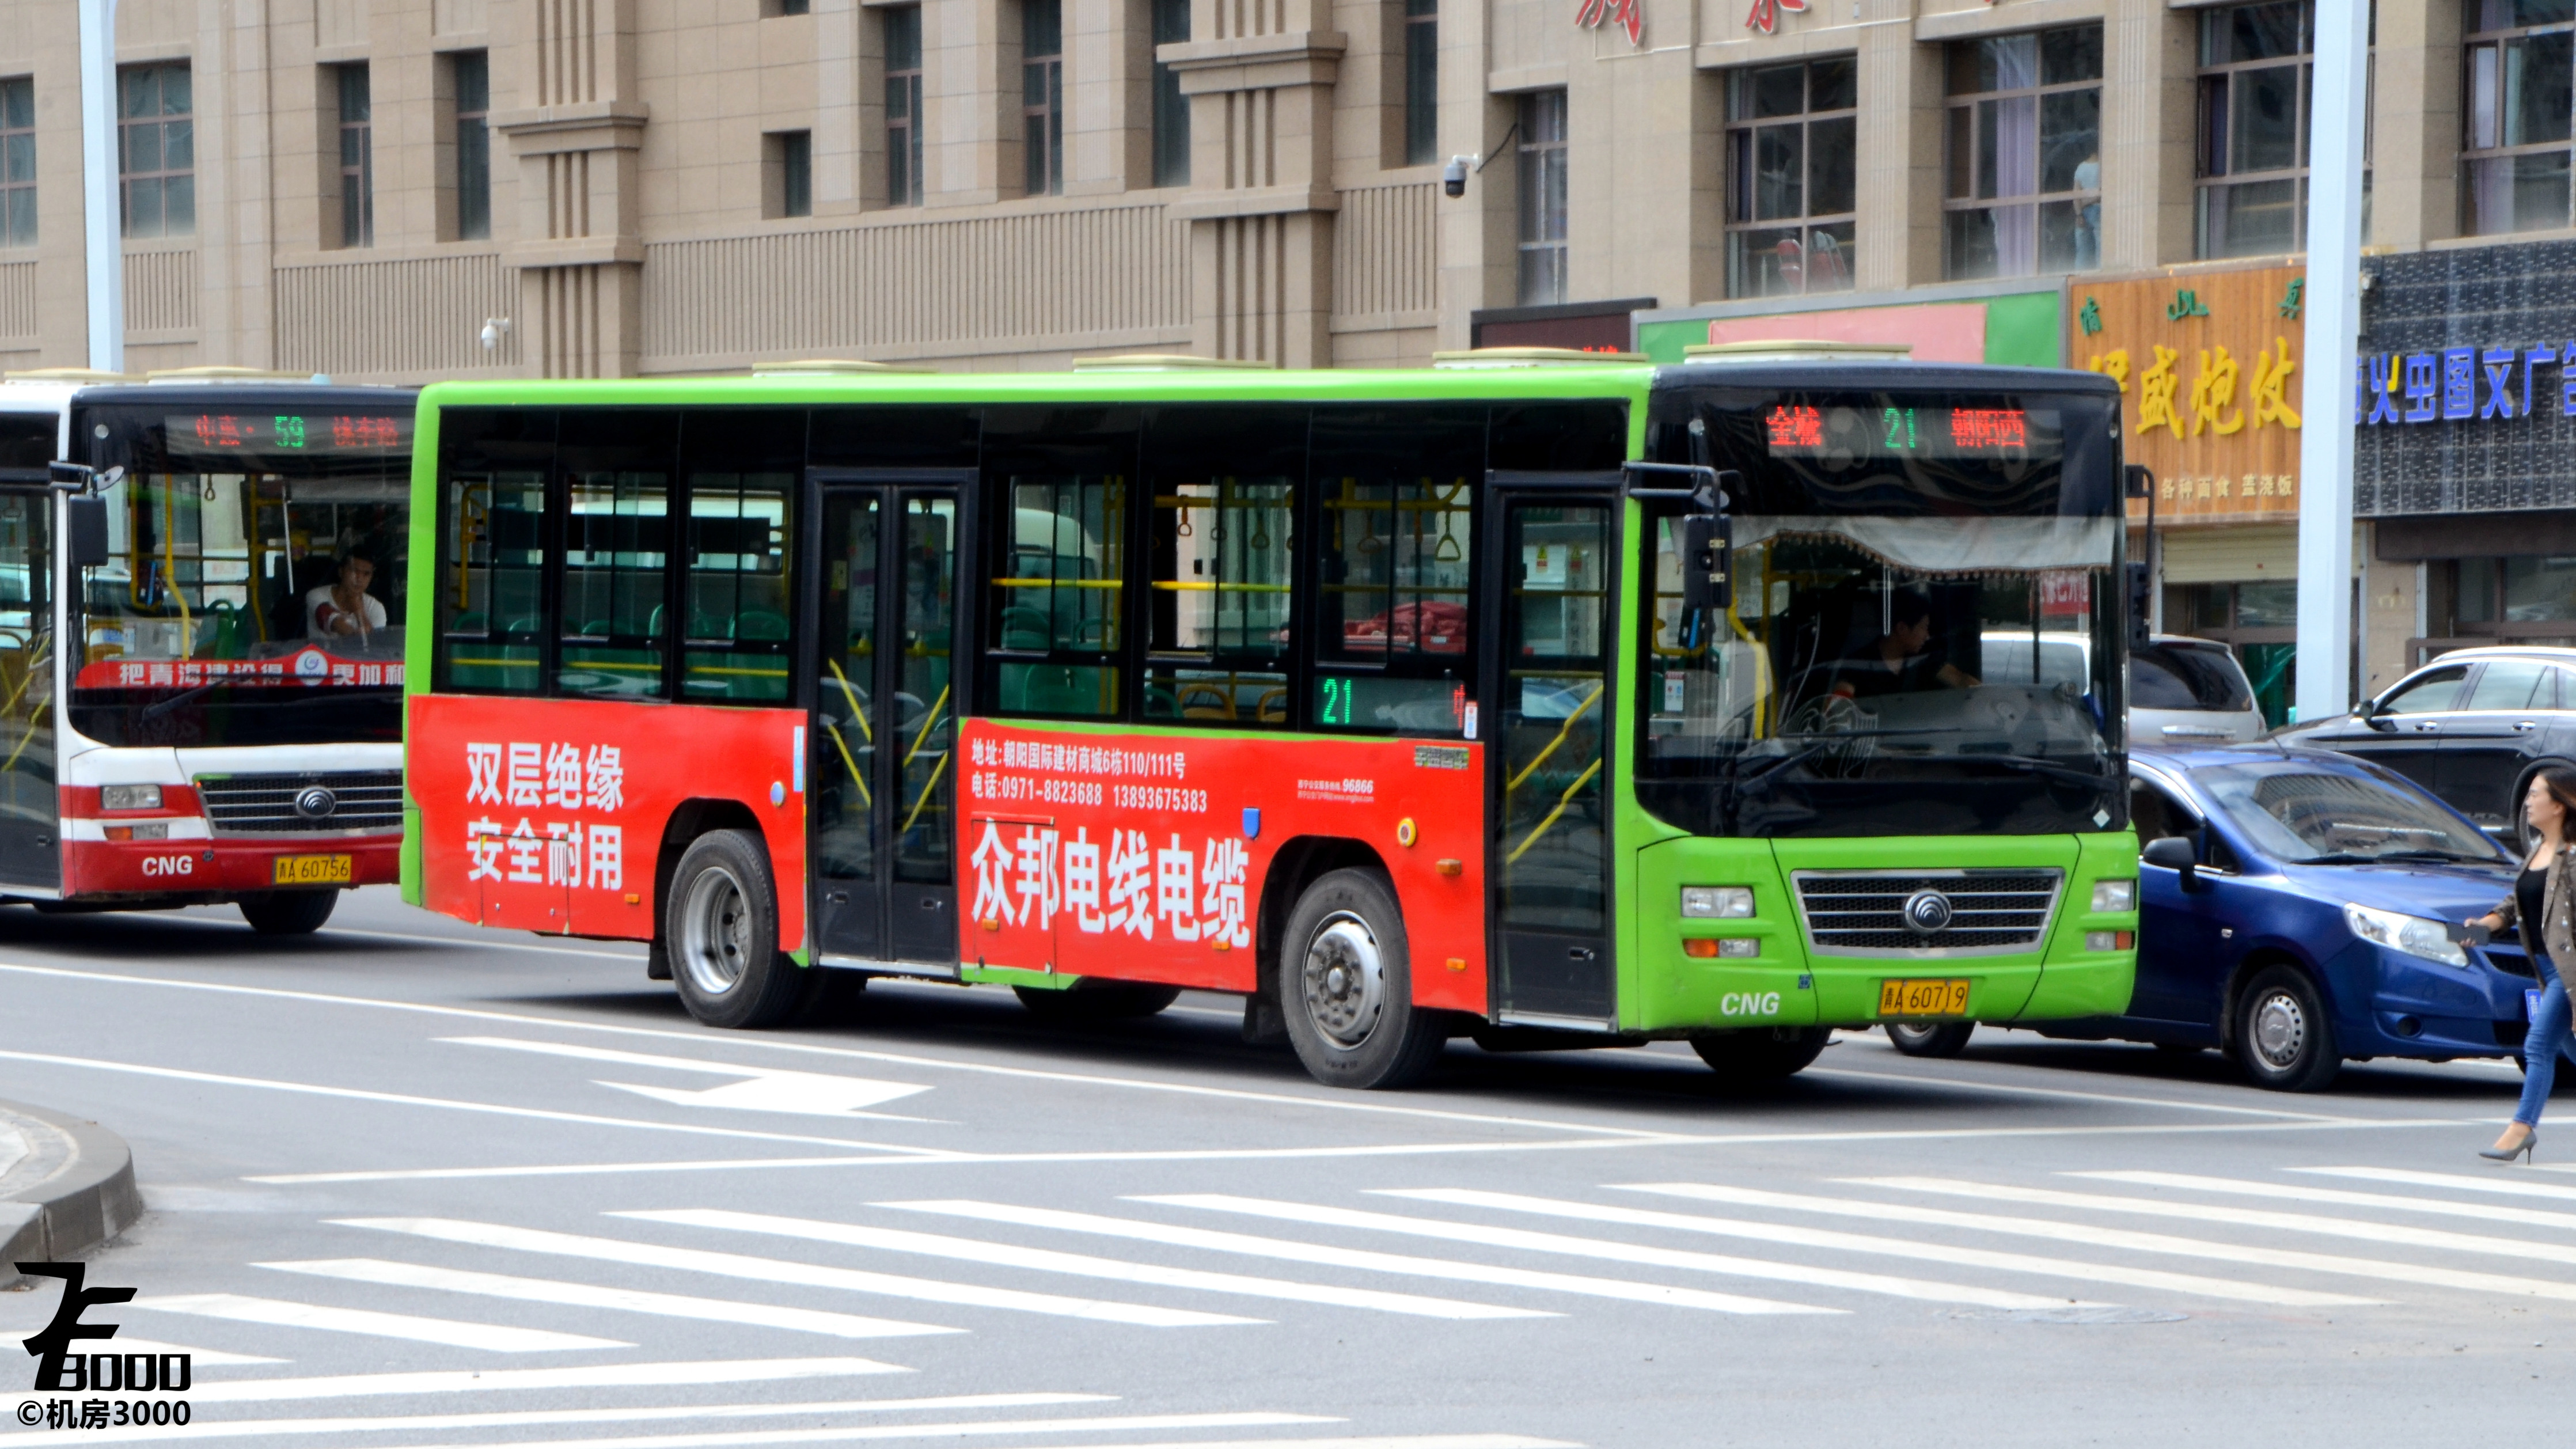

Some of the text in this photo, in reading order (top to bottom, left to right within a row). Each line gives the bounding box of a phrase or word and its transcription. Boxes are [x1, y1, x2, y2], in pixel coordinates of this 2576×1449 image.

[2355, 339, 2576, 424] 火虫图文广
[275, 416, 305, 448] 59
[1884, 408, 1916, 449] 21
[1951, 408, 2025, 448] 朝阳西
[2161, 473, 2293, 500] 各种面食 盖浇饭
[1323, 679, 1352, 724] 21
[466, 742, 624, 813] 双层绝缘
[1342, 779, 1374, 794] 96866
[1113, 787, 1208, 813] 13893675383
[143, 855, 193, 877] CNG
[466, 816, 623, 890] 安全耐用
[970, 817, 1250, 949] 众邦电线电缆
[1721, 992, 1781, 1016] CNG
